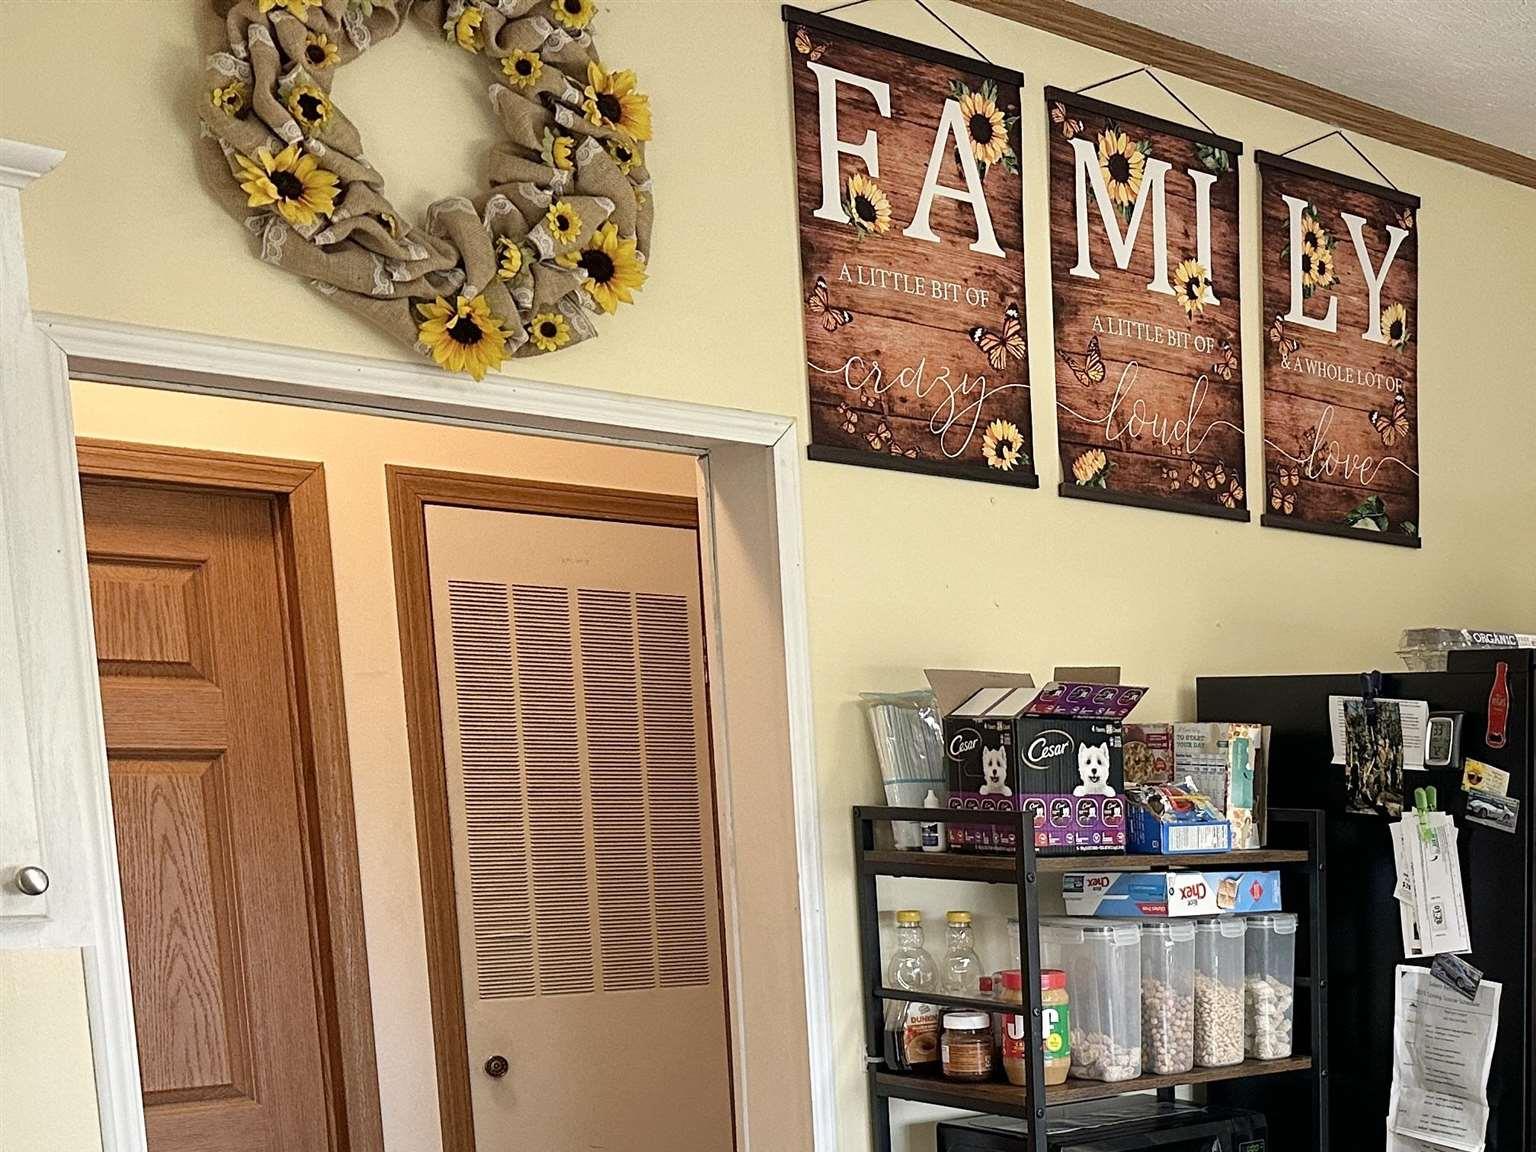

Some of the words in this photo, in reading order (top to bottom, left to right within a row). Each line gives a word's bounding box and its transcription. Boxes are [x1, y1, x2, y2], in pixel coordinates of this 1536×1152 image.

[838, 263, 852, 282] A
[857, 265, 926, 296] LITTLE
[931, 280, 961, 301] BIT
[966, 287, 989, 308] OF
[1092, 316, 1104, 333] A
[1107, 317, 1165, 344] LITTLE
[1167, 328, 1191, 349] BIT
[1194, 335, 1214, 354] OF
[1281, 354, 1290, 370] &
[1294, 357, 1303, 373] A
[1305, 359, 1353, 383] WHOLE
[1357, 370, 1384, 389] LOT
[1385, 376, 1404, 393] OF
[825, 355, 1005, 458] crazy
[1085, 361, 1226, 454] loud
[1290, 405, 1394, 486] love
[1473, 632, 1517, 646] ORGANIC
[949, 735, 979, 756] Cesar
[1028, 737, 1070, 762] Cesar
[1087, 875, 1109, 888] Chex
[1180, 882, 1207, 901] Chex
